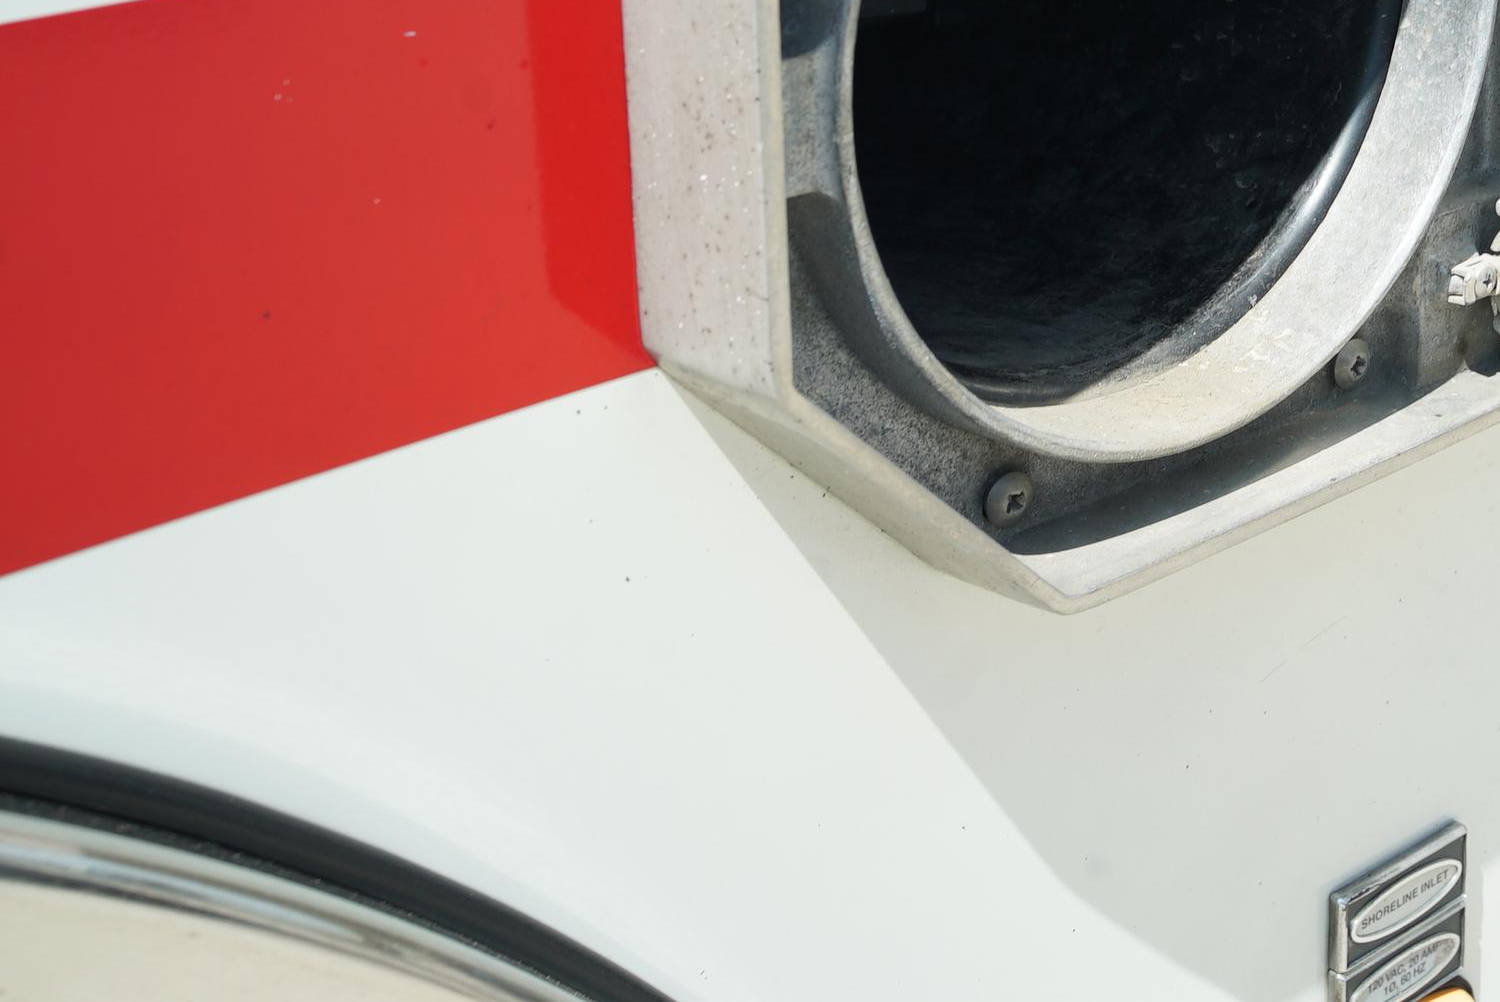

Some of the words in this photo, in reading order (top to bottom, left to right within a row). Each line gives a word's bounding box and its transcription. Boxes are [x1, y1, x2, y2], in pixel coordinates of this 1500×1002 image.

[1361, 888, 1419, 930] SHORELINE
[1420, 869, 1450, 894] INLET
[1367, 976, 1385, 994] 120
[1408, 954, 1420, 968] 20
